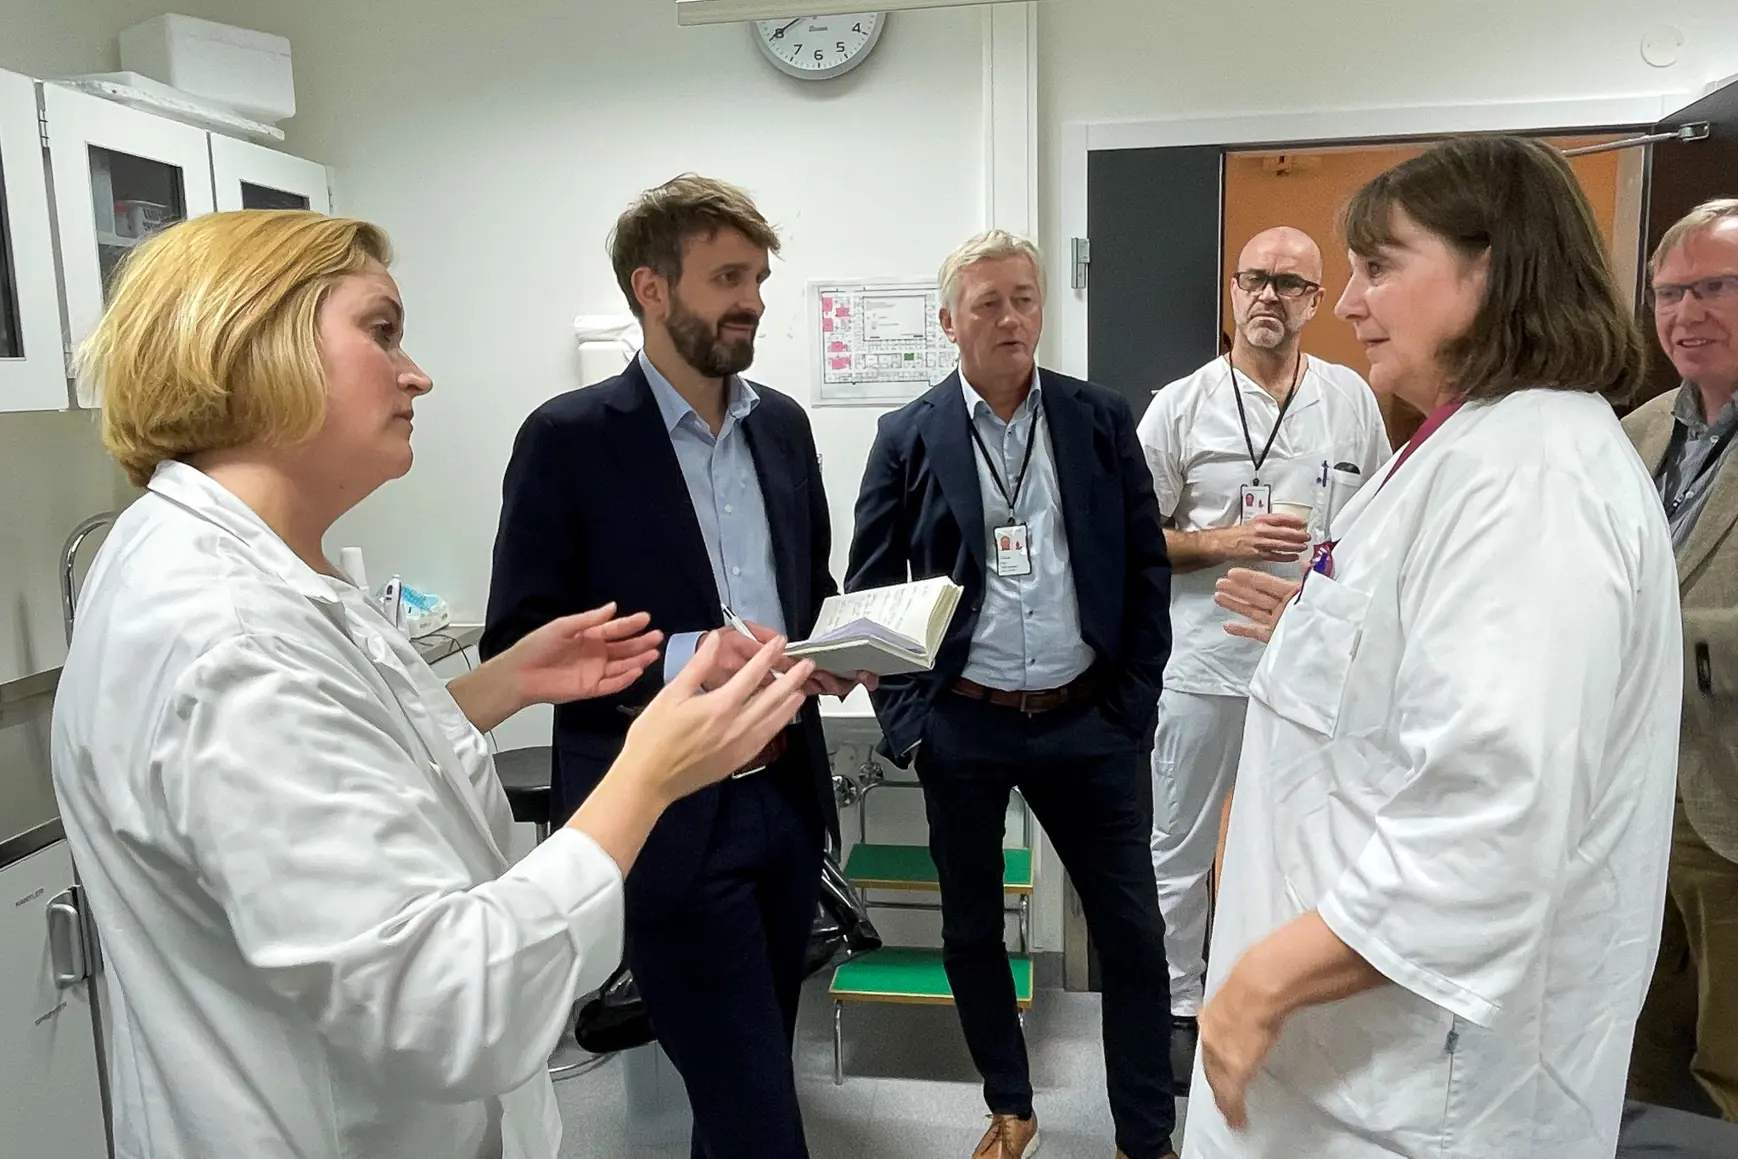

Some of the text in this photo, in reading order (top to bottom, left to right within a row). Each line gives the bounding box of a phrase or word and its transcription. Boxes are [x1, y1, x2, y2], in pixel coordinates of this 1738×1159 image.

[852, 22, 861, 33] 4
[775, 28, 785, 38] 8
[794, 44, 803, 55] 7
[836, 42, 845, 52] 5
[814, 50, 824, 60] 6
